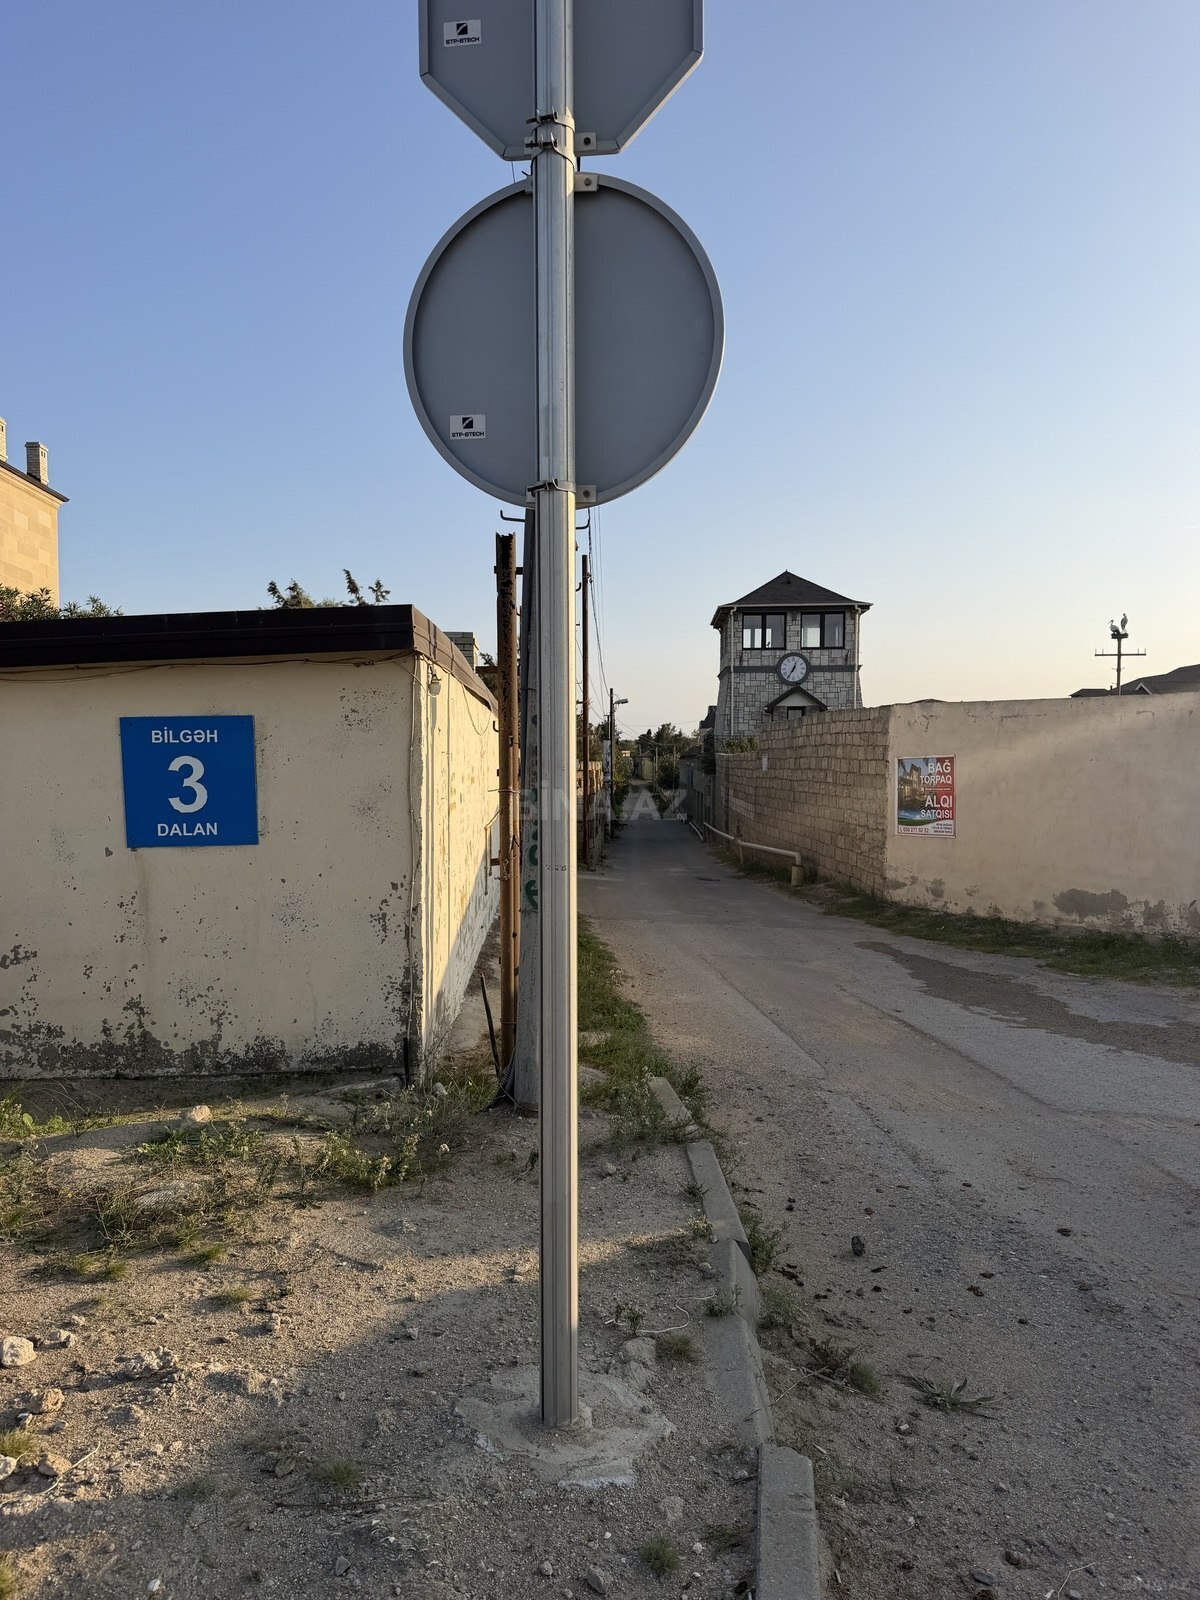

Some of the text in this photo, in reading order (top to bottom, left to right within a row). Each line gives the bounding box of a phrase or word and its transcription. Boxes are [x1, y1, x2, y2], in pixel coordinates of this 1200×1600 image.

[151, 727, 218, 743] BİLGƏH
[928, 760, 951, 773] BAĞ
[168, 755, 208, 813] 3
[920, 775, 952, 784] TORPAQ
[925, 795, 952, 808] ALQI
[157, 822, 218, 837] DALAN
